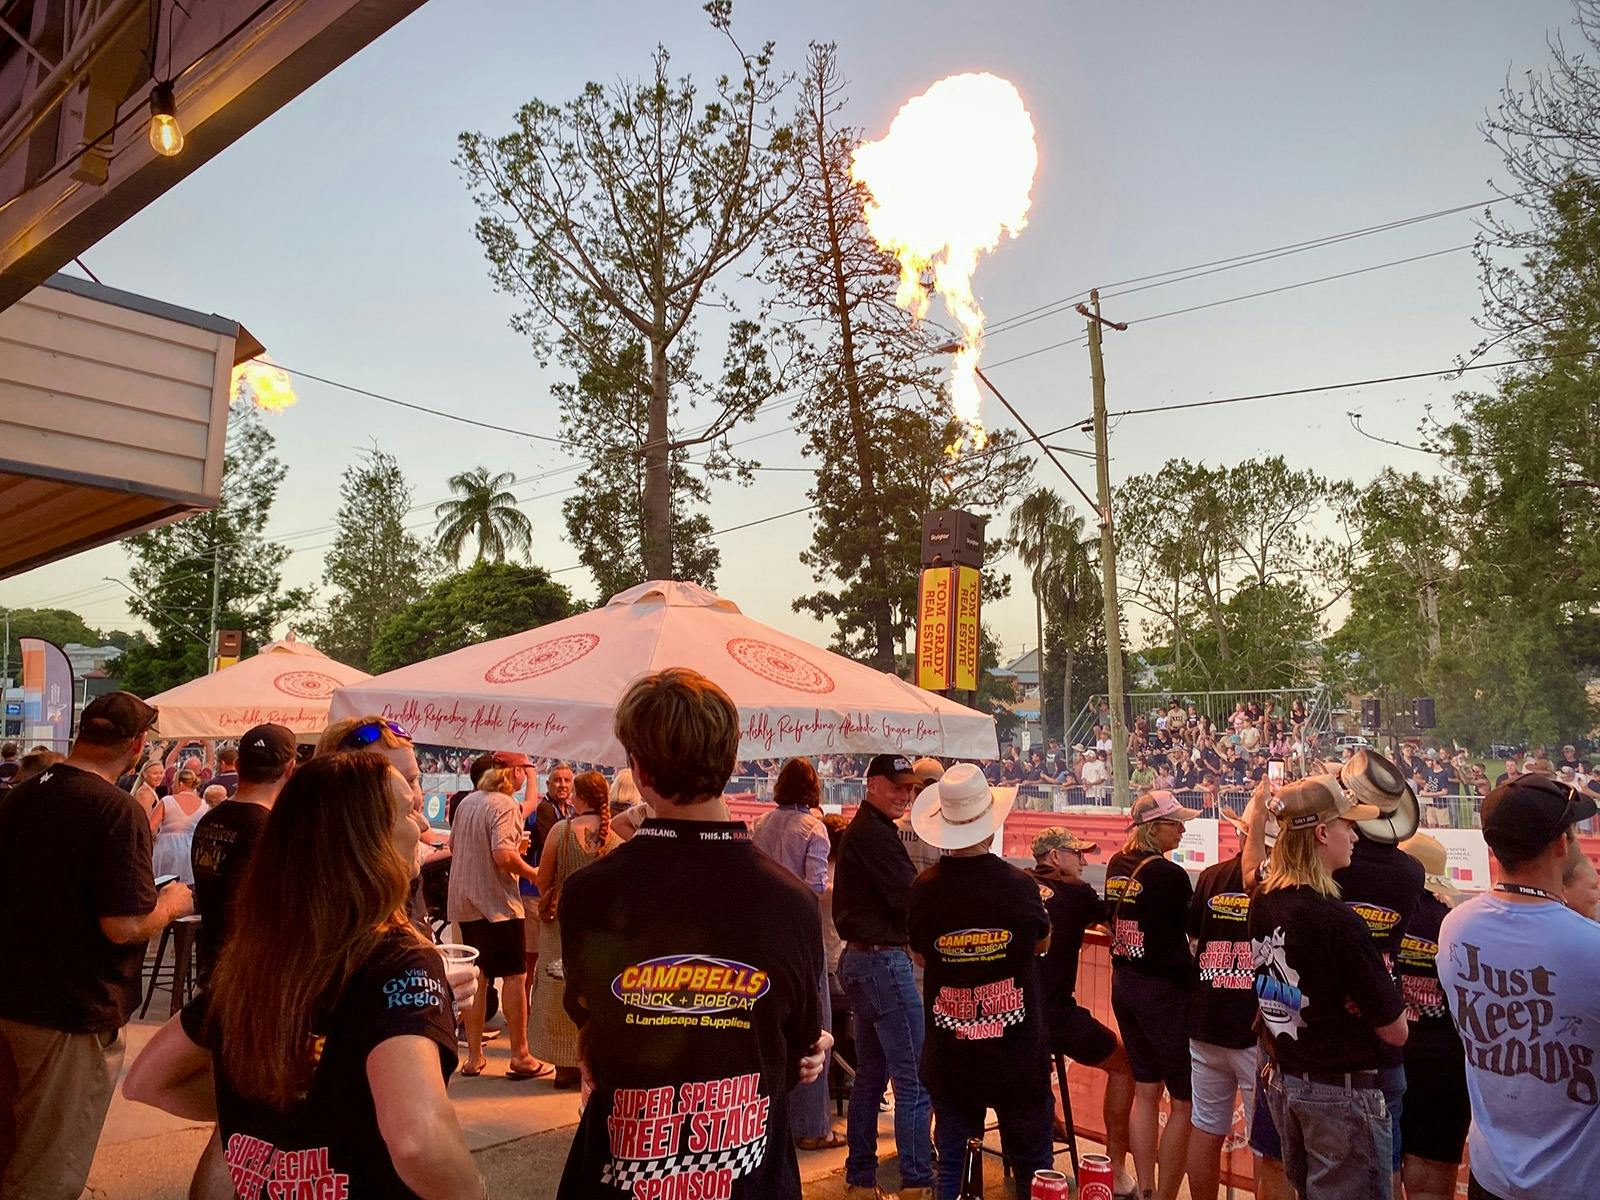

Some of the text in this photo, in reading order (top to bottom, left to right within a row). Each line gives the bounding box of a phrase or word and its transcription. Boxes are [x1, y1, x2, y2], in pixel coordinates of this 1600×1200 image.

[923, 591, 935, 668] REAL ESTATE
[934, 580, 947, 677] TOM GRADY
[959, 589, 968, 666] REAL ESTATE
[968, 582, 976, 678] TOM GRADY
[508, 709, 542, 746] Ginger
[544, 713, 568, 736] Beer
[777, 709, 836, 747] Refreshing
[882, 717, 913, 749] Ginger
[916, 720, 939, 740] Beer
[938, 930, 1009, 948] CAMPBELLS
[405, 968, 428, 977] Visit
[1200, 952, 1236, 970] STREET
[1457, 942, 1556, 998] Just
[621, 965, 768, 995] CAMPBELLS
[940, 977, 1015, 1001] SUPER SPECIAL
[1212, 975, 1252, 990] SPONSOR
[622, 993, 674, 1006] TRUCK
[693, 994, 758, 1011] BOBCAT
[933, 988, 1024, 1020] STREET STAGE
[1454, 984, 1554, 1044] Keep
[626, 1014, 750, 1029] & Landscape Supplies
[956, 1021, 1004, 1040] SPONSOR
[613, 1073, 761, 1118] SUPER SPECIAL
[688, 1096, 770, 1153] STAGE
[224, 1133, 274, 1174] SUPER
[632, 1168, 734, 1200] SPONSOR
